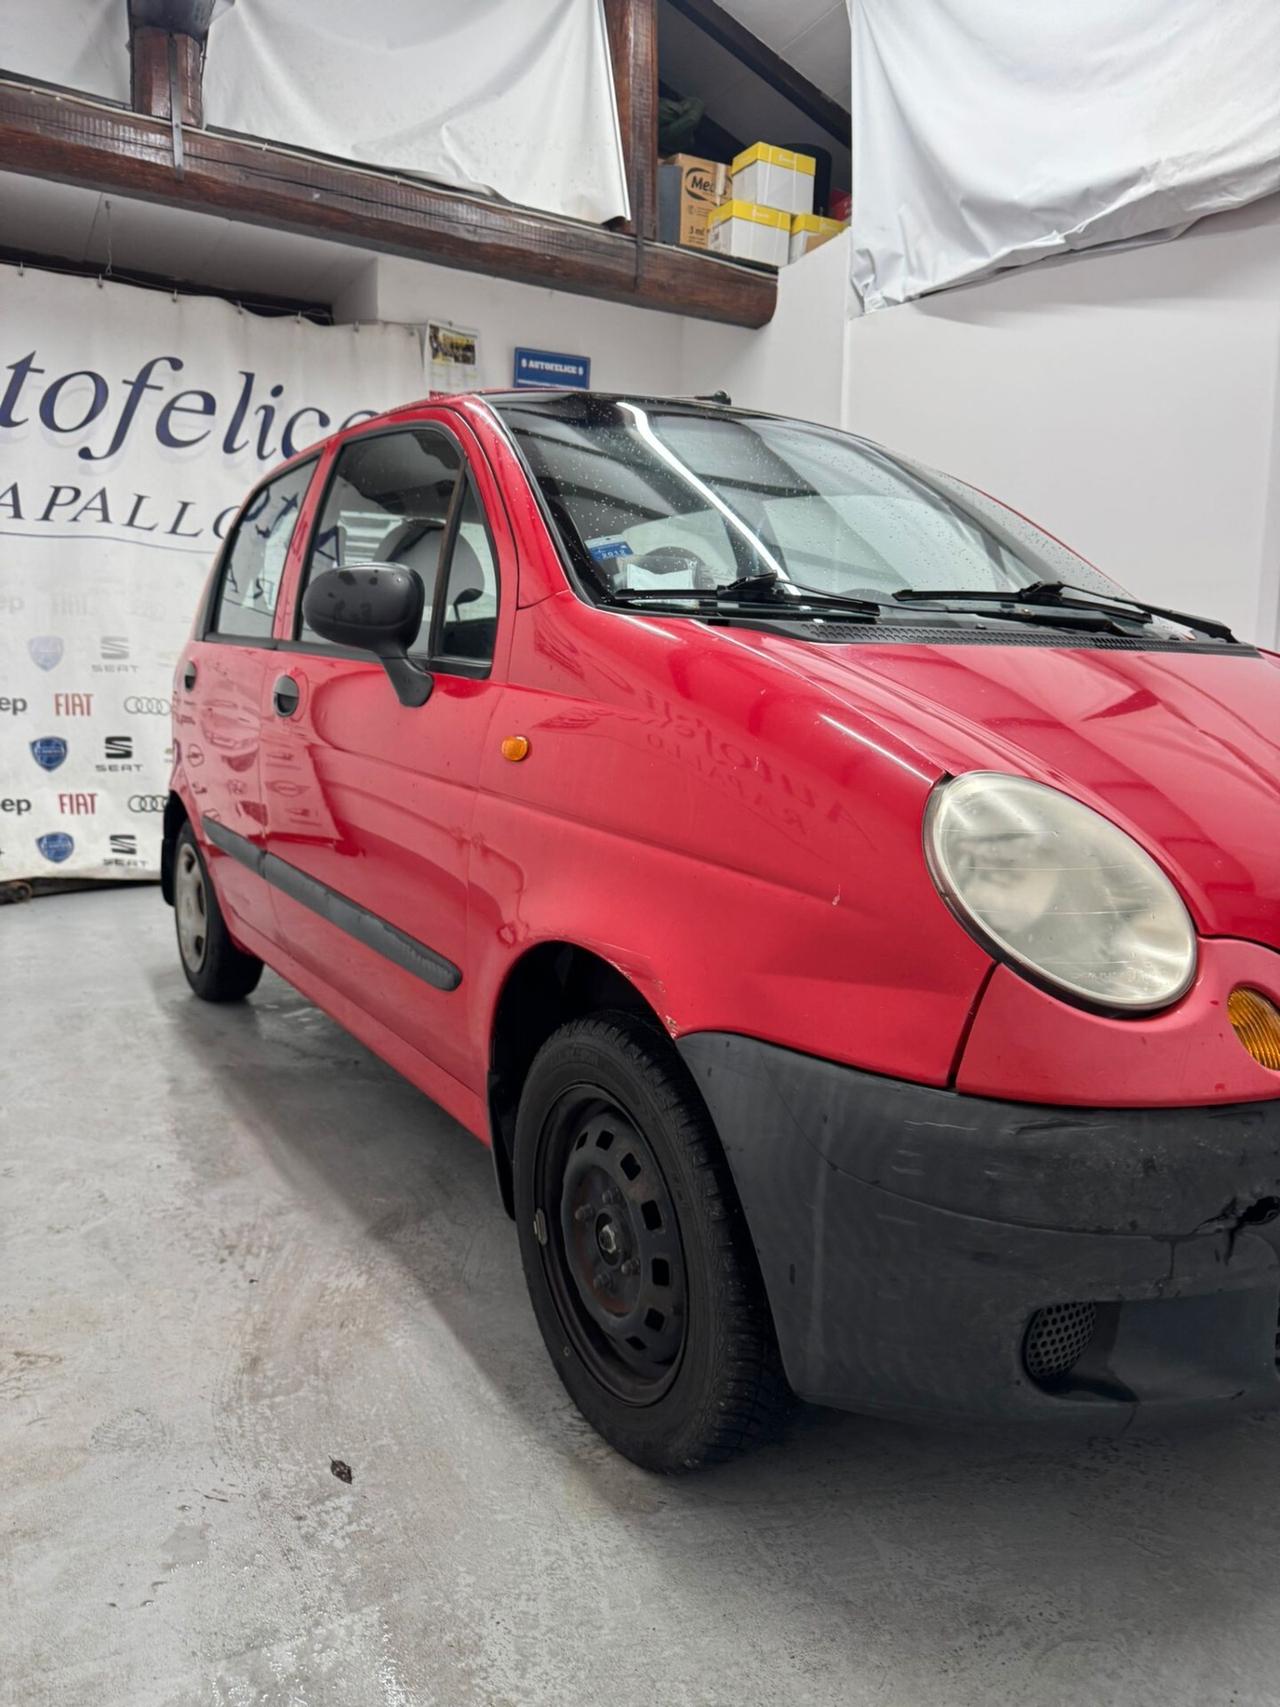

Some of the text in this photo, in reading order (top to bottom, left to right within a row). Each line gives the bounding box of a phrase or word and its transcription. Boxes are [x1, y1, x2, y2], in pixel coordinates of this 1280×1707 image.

[0, 350, 378, 462] tofelic
[54, 693, 94, 717] FIAT
[95, 764, 144, 773] SEAT
[58, 793, 98, 815] FIAT
[103, 858, 149, 868] SEAT
